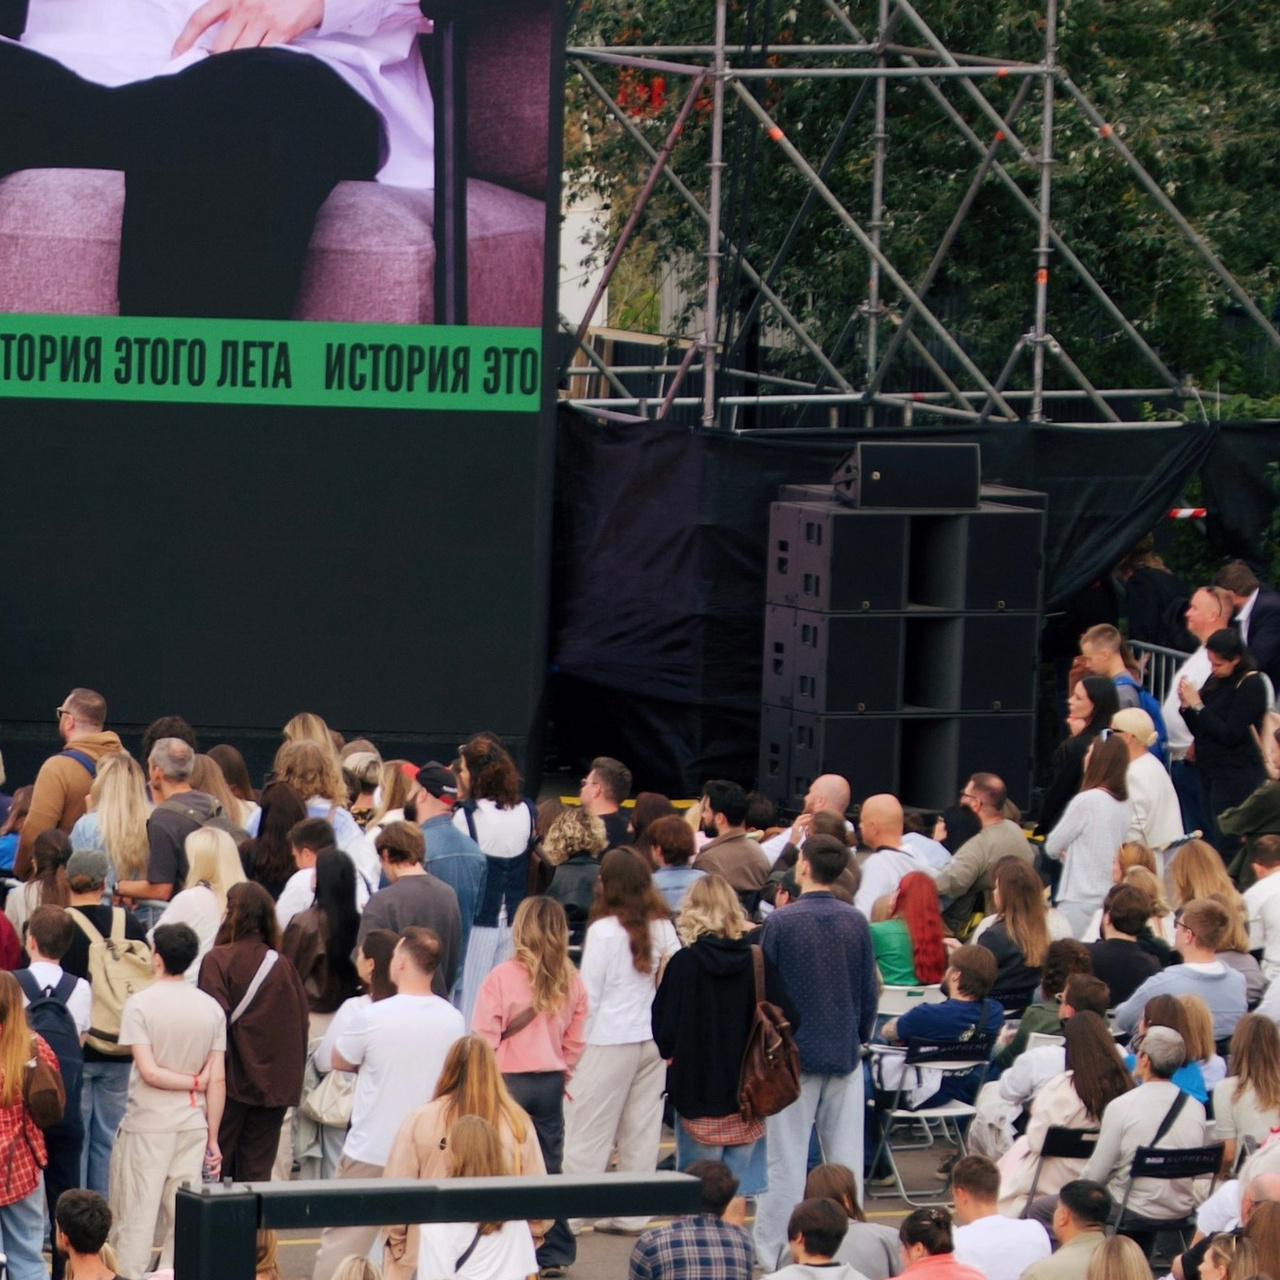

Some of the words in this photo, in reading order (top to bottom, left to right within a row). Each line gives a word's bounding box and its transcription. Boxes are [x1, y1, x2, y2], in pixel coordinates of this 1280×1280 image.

[114, 336, 207, 387] ЭТОГО
[216, 339, 293, 389] ЛЕТА
[324, 342, 470, 394] ИСТОРИЯ
[482, 346, 540, 397] ЭТО
[1166, 1155, 1216, 1163] SUPREME
